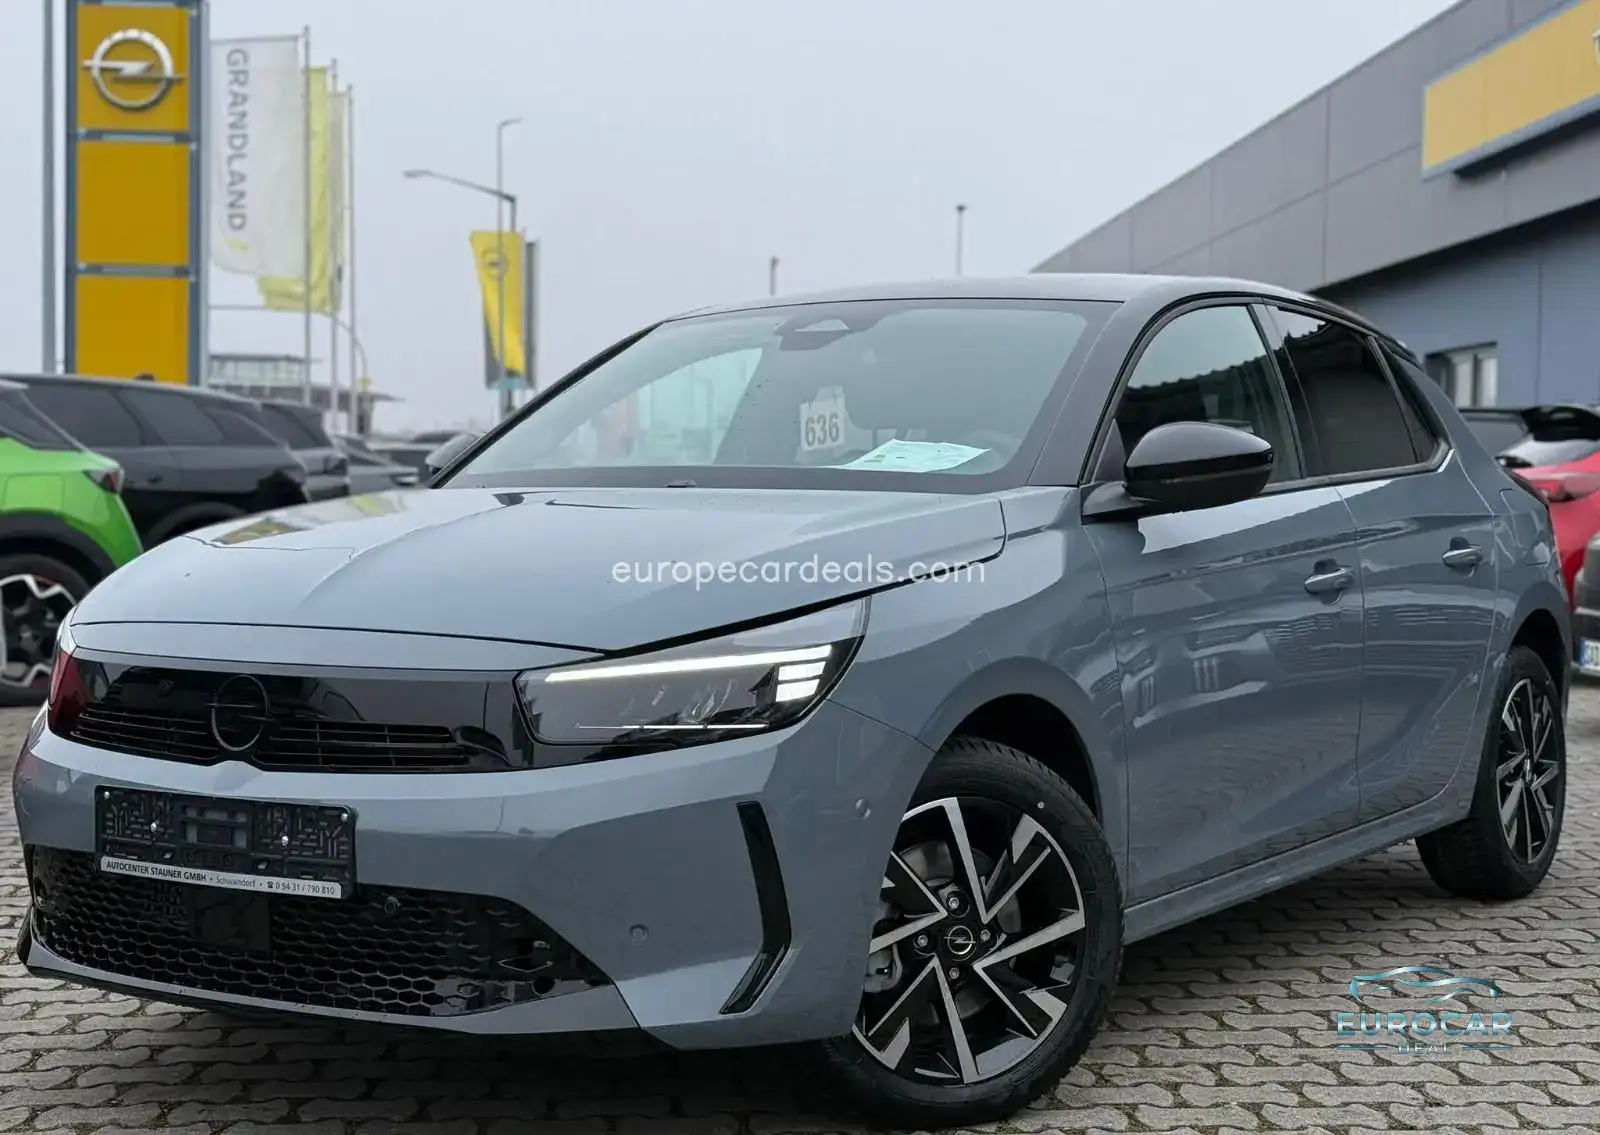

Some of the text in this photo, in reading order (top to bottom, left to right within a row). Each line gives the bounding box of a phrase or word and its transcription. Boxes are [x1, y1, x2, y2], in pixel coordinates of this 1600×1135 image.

[226, 49, 248, 231] GRANDLAND
[805, 412, 840, 446] 636
[106, 860, 149, 875] AUTOCENTER
[150, 866, 182, 880] STAUNER
[183, 871, 206, 883] GMBH
[216, 875, 256, 888] Schwandorf
[307, 884, 320, 894] 790
[321, 885, 335, 896] 810
